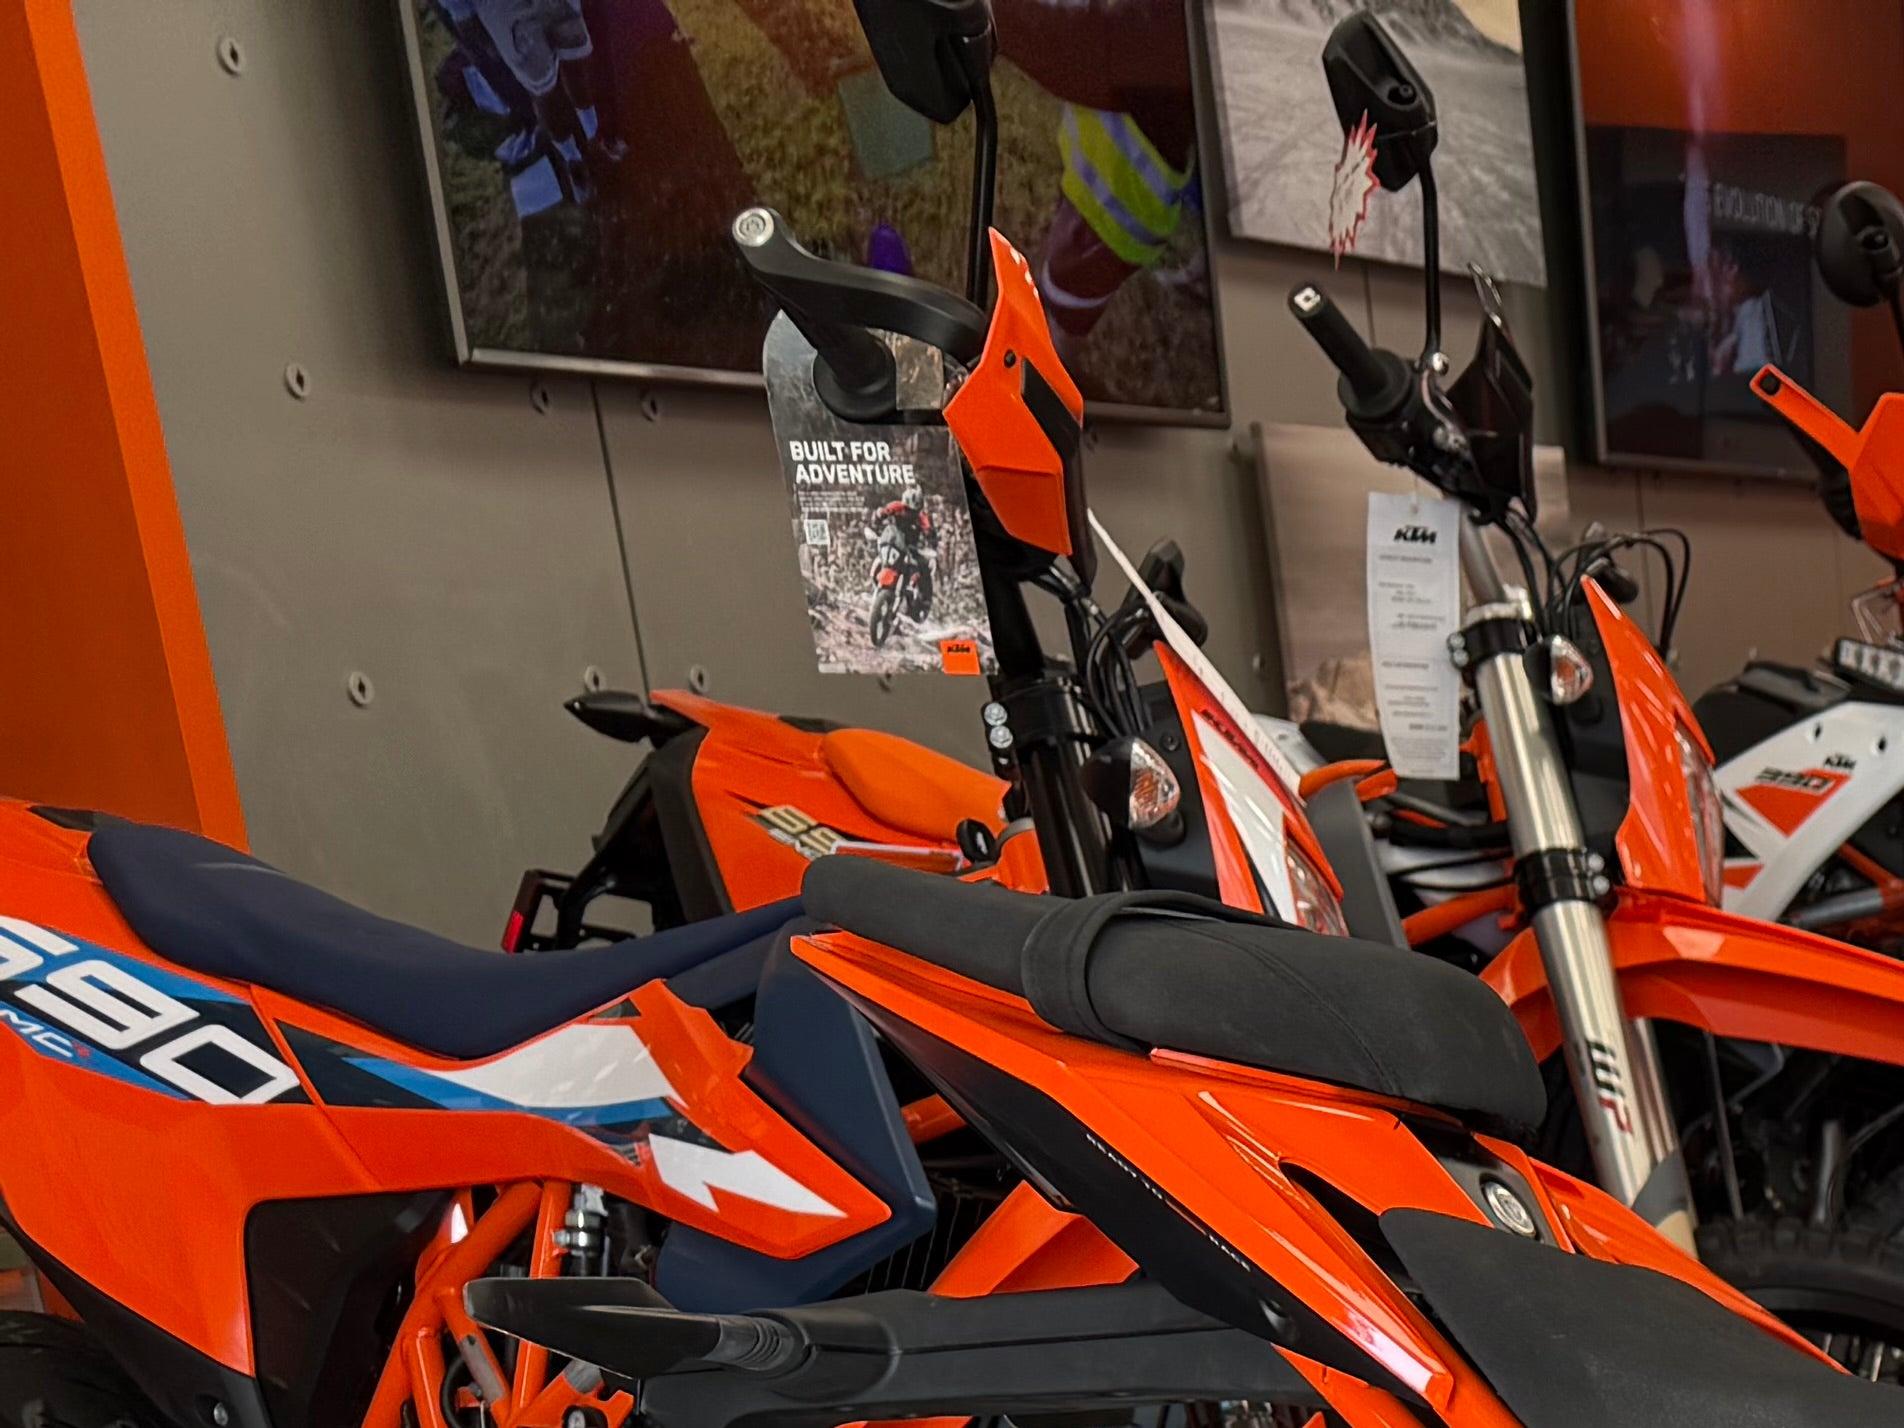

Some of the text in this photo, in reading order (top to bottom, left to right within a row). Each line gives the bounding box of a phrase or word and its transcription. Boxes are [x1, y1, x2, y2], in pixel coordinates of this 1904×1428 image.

[789, 440, 891, 462] BUILT FOR
[795, 463, 917, 485] ADVENTURE
[1393, 525, 1438, 546] KTM
[0, 1008, 73, 1058] MC
